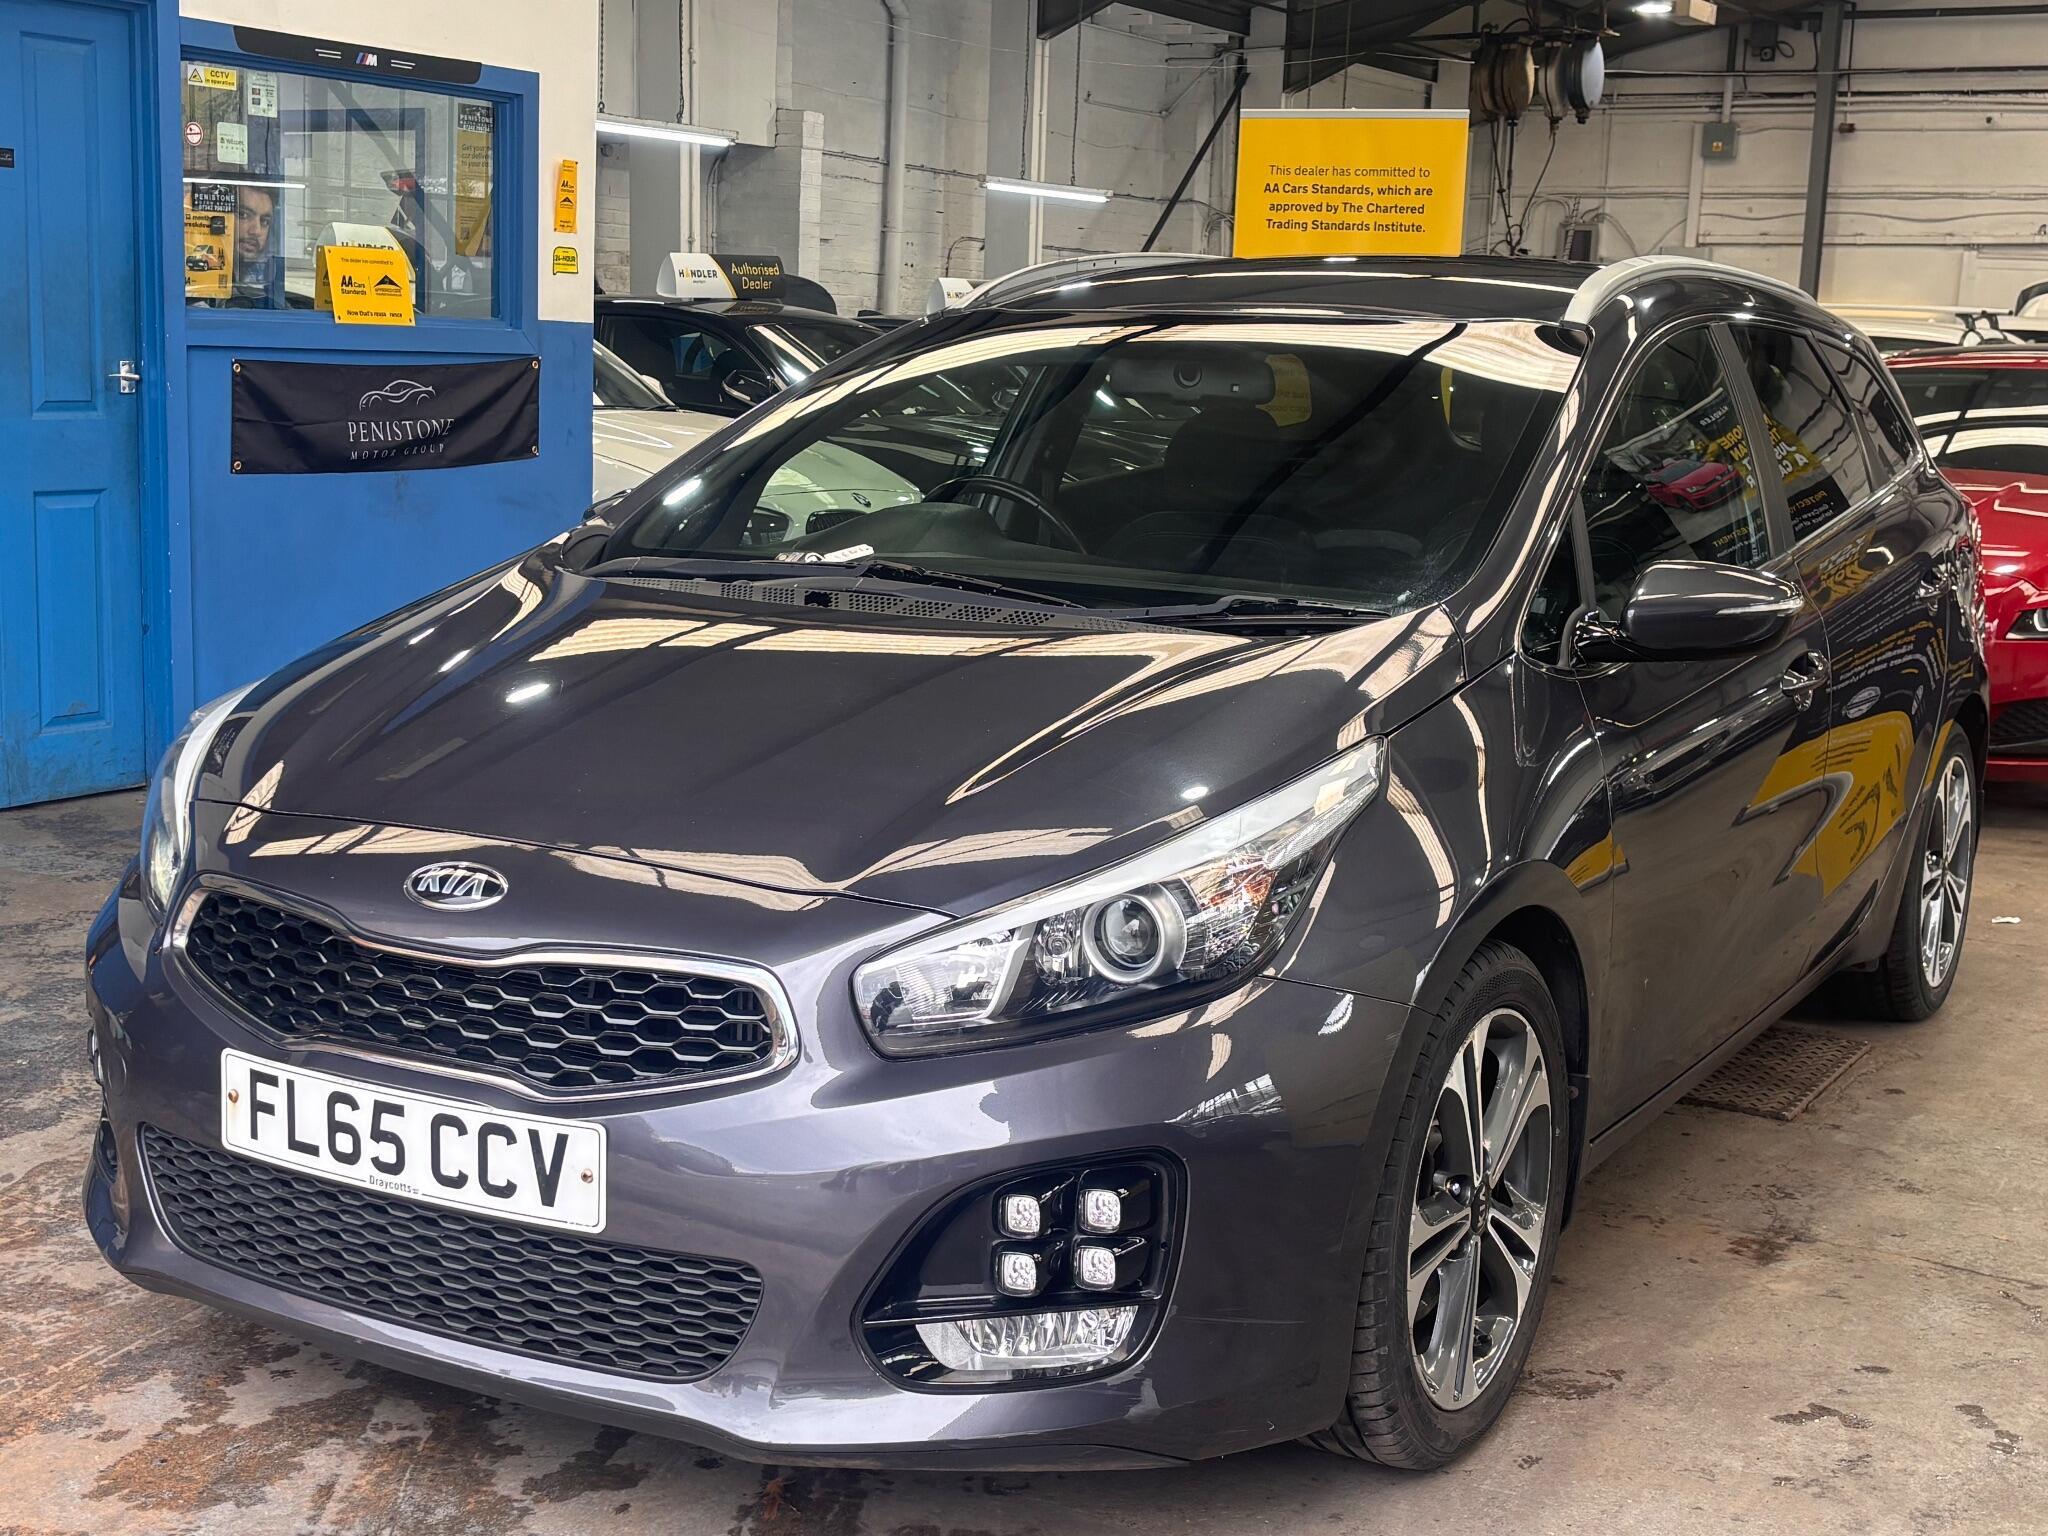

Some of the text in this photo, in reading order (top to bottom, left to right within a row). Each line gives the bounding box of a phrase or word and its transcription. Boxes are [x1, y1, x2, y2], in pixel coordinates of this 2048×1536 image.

[210, 70, 230, 79] CCTV
[1269, 164, 1431, 178] This dealer has committed to
[1263, 183, 1433, 197] AA Cars Standards, which are
[1268, 202, 1425, 215] approved by The Chartered
[1265, 218, 1426, 233] Trading Standards Institute.
[678, 267, 719, 279] HANDLER
[730, 262, 780, 276] Authorised
[341, 274, 354, 288] AA
[354, 281, 366, 289] Cars
[742, 276, 773, 290] Dealer
[340, 287, 367, 296] Standards
[347, 309, 359, 317] Now
[347, 418, 455, 442] PENISTONE
[350, 443, 445, 460] MOTOR GROUP
[416, 868, 489, 900] KIA
[250, 1067, 569, 1208] FL65 CCV
[369, 1174, 412, 1193] Draycotts
[1477, 1185, 1486, 1228] KIA
